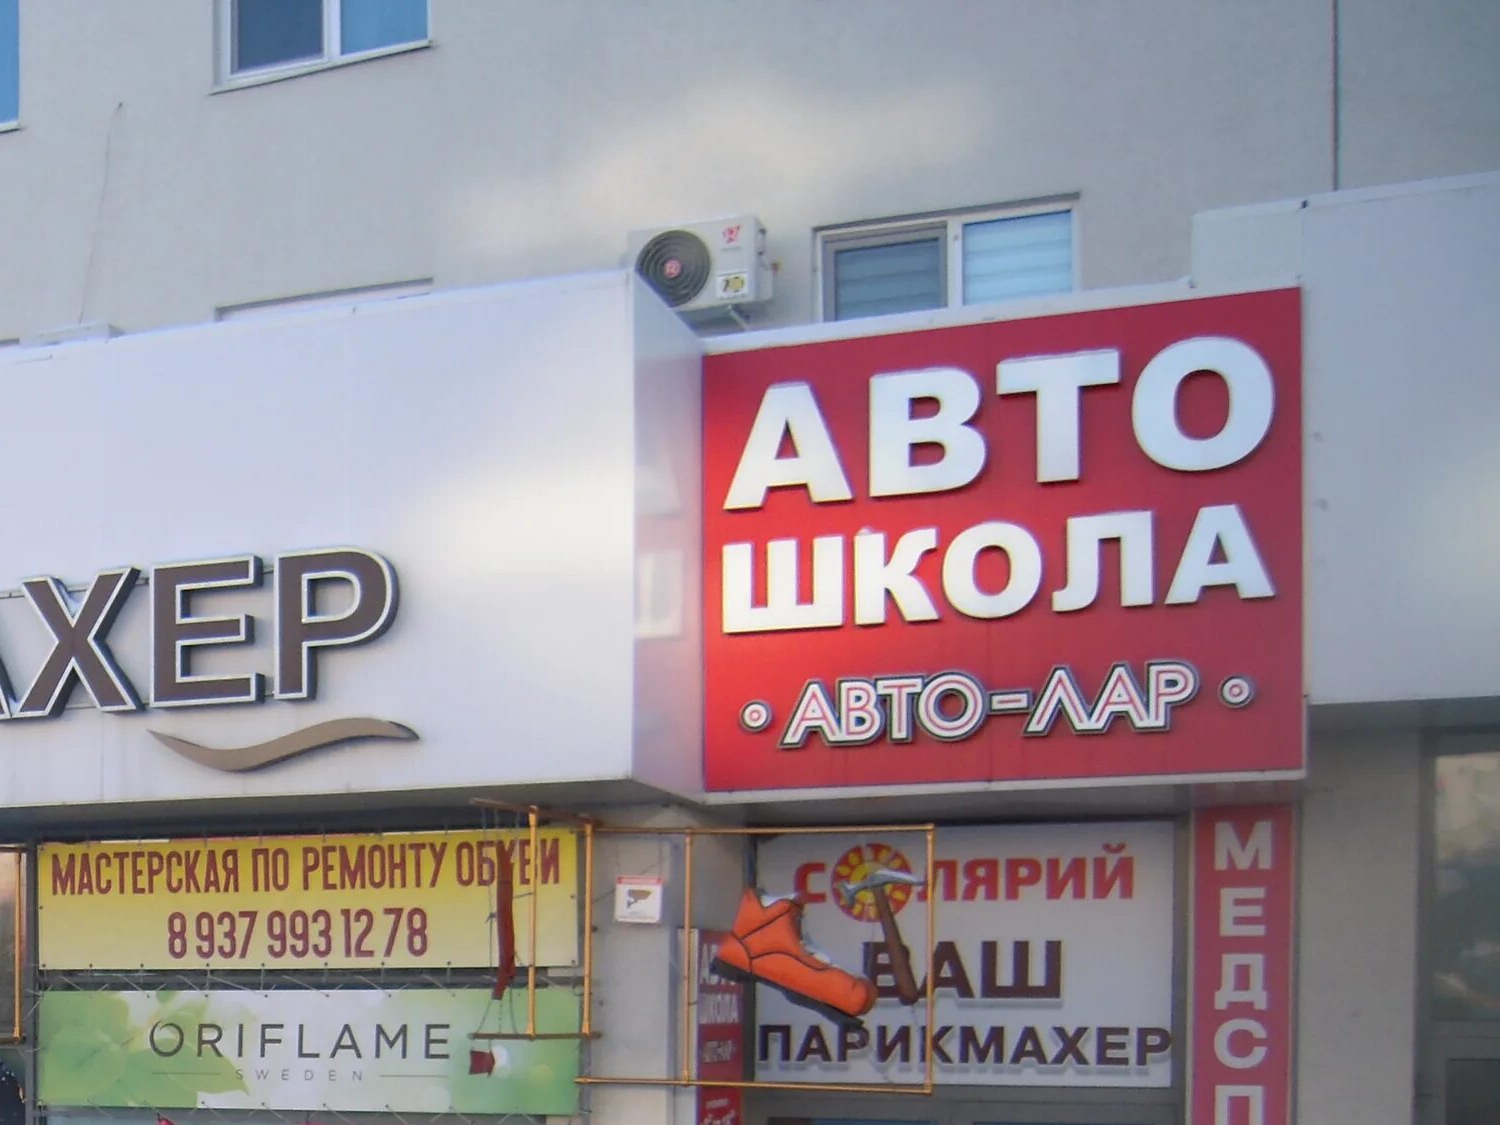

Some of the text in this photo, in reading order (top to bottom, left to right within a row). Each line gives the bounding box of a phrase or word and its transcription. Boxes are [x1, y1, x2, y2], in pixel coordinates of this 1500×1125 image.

[723, 336, 1276, 510] АВТО
[722, 504, 1275, 633] ШКОЛА
[780, 661, 1200, 749] АВТО-ЛАР
[52, 849, 239, 896] МАСТЕРСКАЯ
[252, 847, 289, 892] ПО
[302, 842, 448, 891] РЕМОНТУ
[862, 940, 1062, 1000] ВАШ
[148, 1019, 452, 1060] ORIFLAME
[758, 1024, 1173, 1067] ПАРИКМАХЕР
[235, 1069, 364, 1082] SWEDEN
